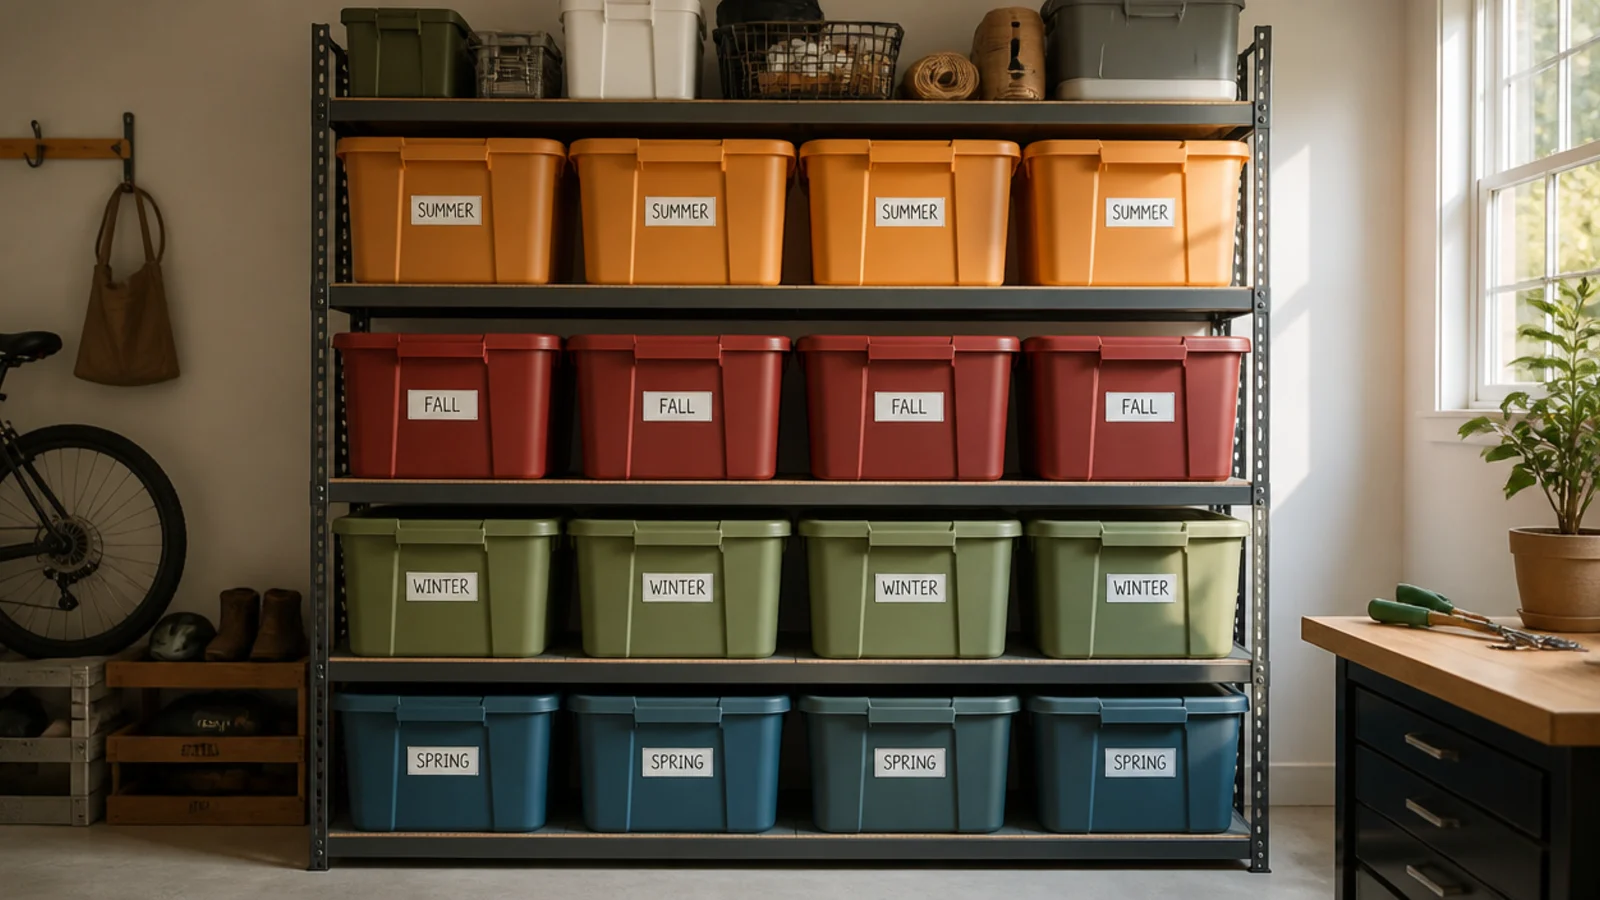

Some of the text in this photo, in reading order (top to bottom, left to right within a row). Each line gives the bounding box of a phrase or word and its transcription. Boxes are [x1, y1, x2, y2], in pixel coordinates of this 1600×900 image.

[418, 201, 475, 218] SUMMER
[652, 202, 709, 220] SUMMER
[882, 203, 938, 220] SUMMER
[1112, 203, 1168, 221] SUMMER
[424, 395, 460, 413] FALL
[659, 397, 695, 414] FALL
[892, 398, 927, 415] FALL
[1122, 398, 1158, 415] FALL
[413, 578, 470, 595] WINTER
[649, 578, 706, 596] WINTER
[882, 579, 938, 596] WINTER
[1113, 579, 1169, 596] WINTER
[416, 752, 470, 769] SPRING
[651, 753, 704, 770] SPRING
[883, 754, 937, 771] SPRING
[1114, 754, 1167, 771] SPRING
